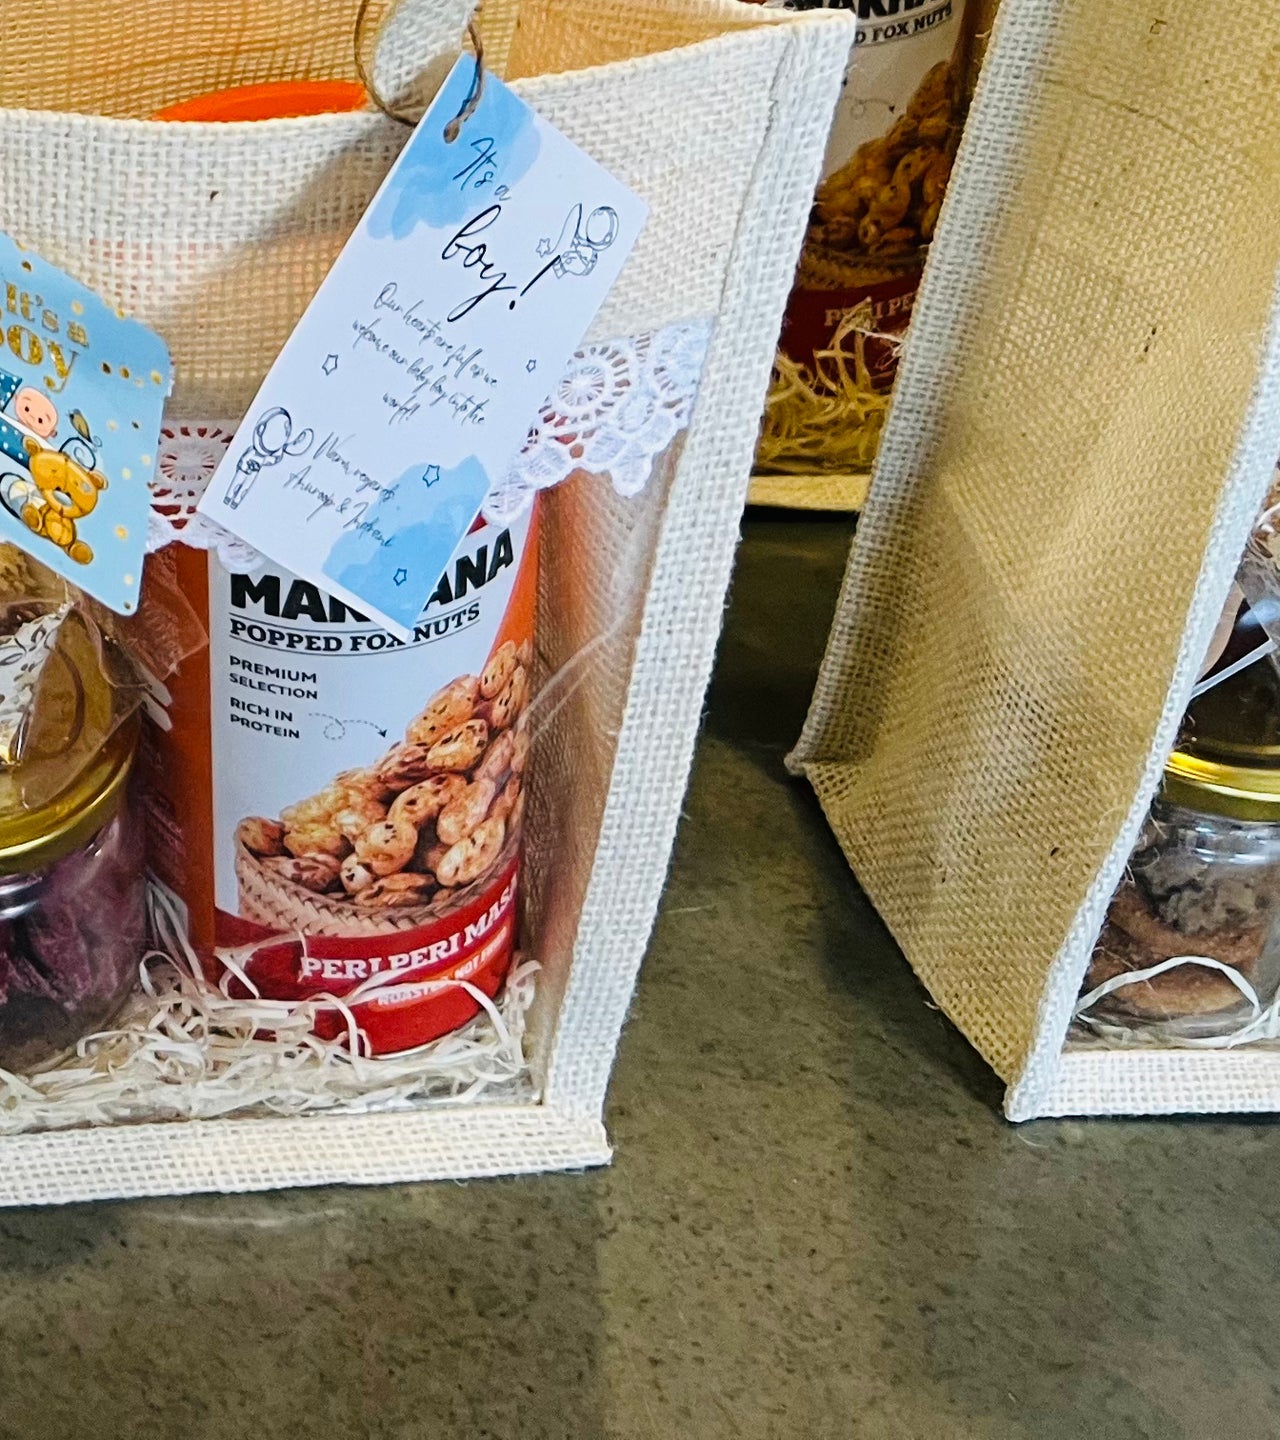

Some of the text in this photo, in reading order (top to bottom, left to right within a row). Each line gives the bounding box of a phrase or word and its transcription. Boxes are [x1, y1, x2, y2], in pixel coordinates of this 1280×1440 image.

[494, 184, 511, 201] a
[442, 204, 561, 322] boy!
[229, 602, 480, 652] POPPED FOX NUTS
[229, 655, 317, 684] PREMIUM
[229, 672, 318, 700] SELECTION
[230, 697, 293, 722] RICH IN
[230, 713, 300, 739] PROTEIN
[300, 956, 382, 980] PERI
[388, 932, 461, 971] PERI
